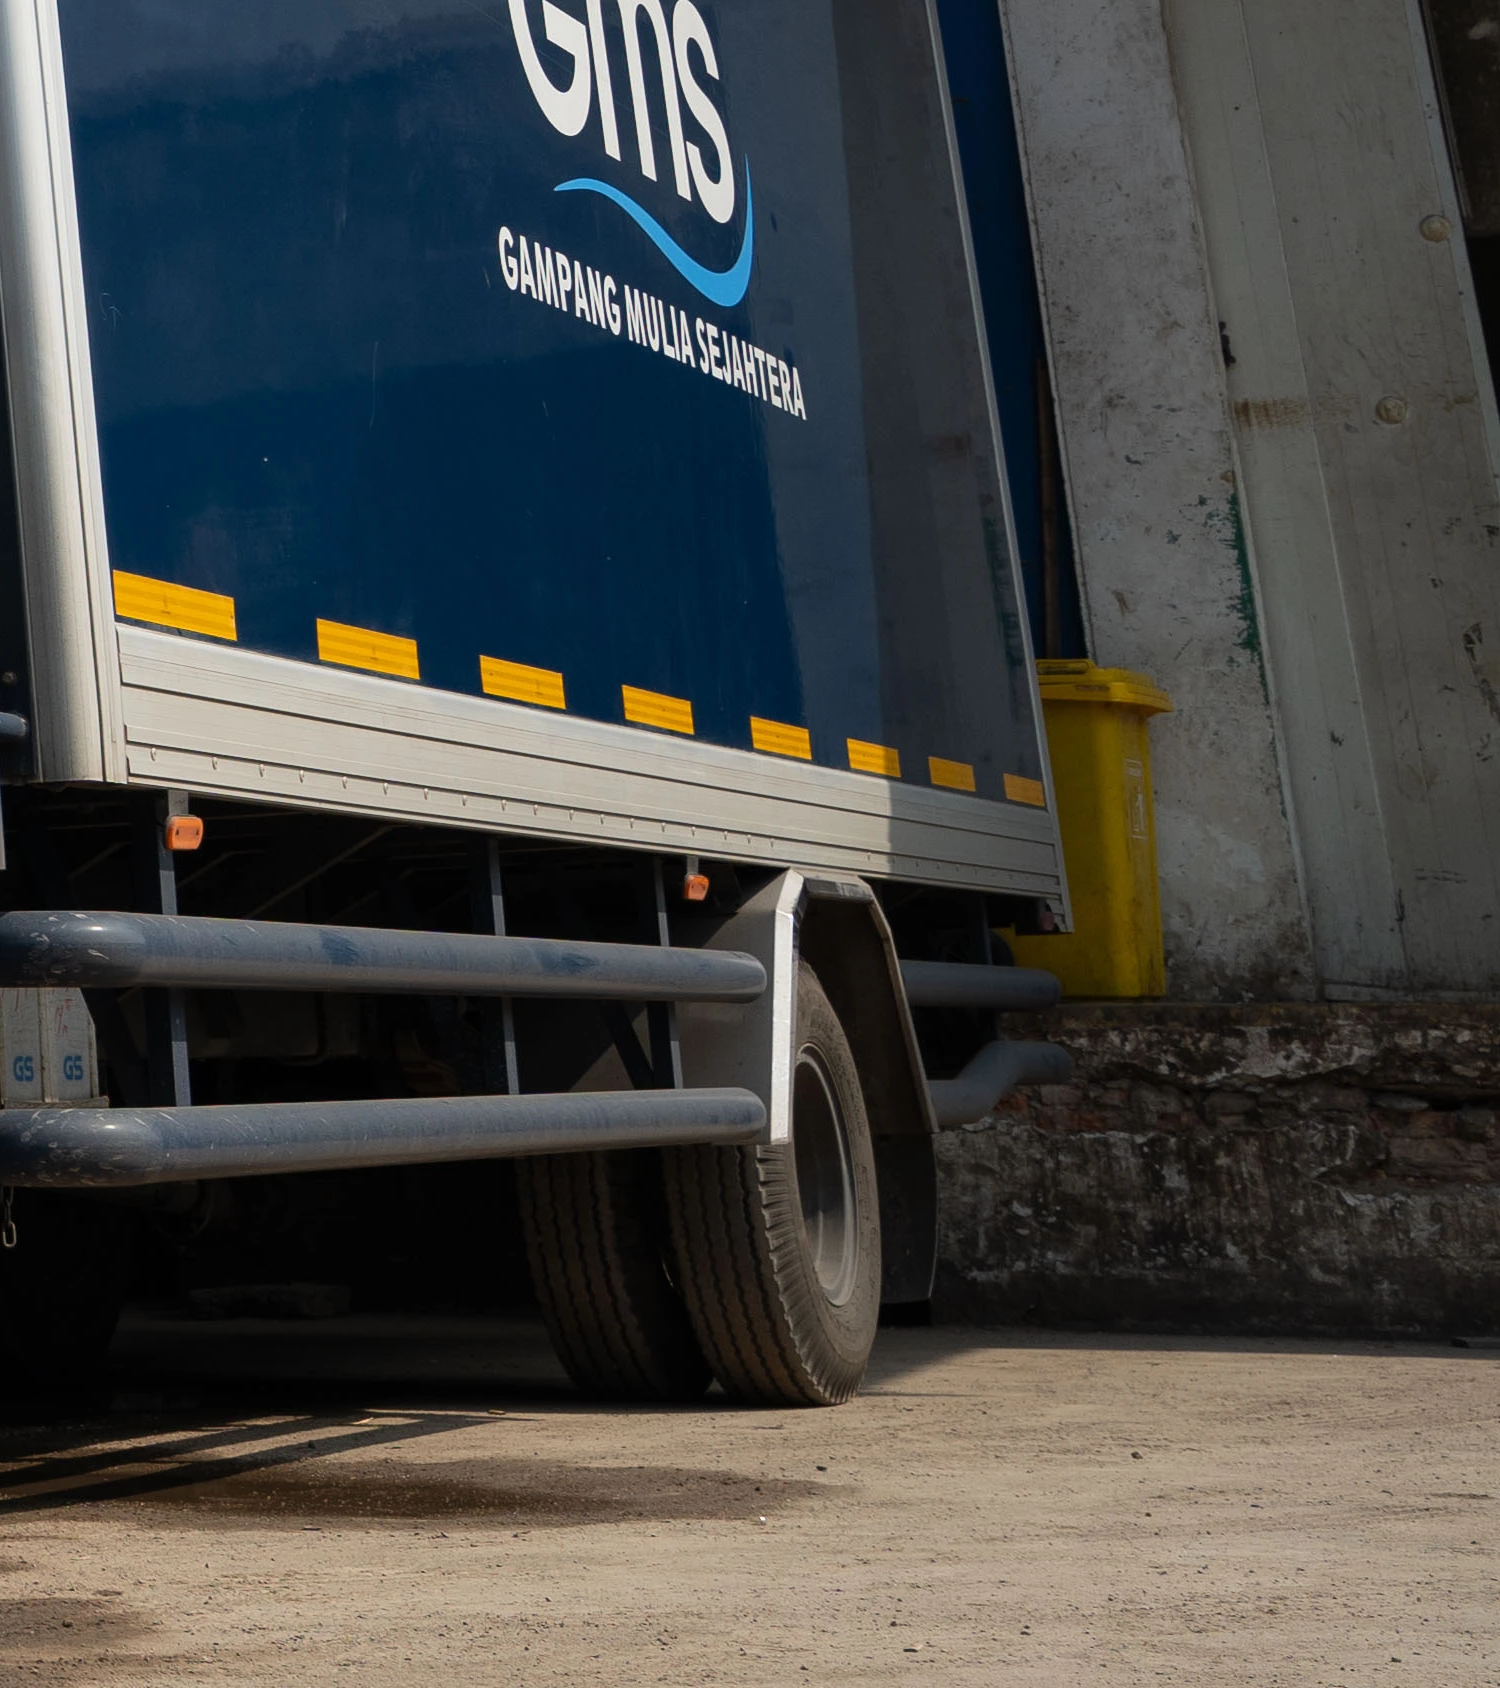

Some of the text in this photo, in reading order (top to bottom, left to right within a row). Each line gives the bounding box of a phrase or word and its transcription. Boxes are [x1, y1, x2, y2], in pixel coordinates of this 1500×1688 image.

[499, 226, 807, 421] GAMPANG MULIA SEJAHTERA
[12, 1055, 84, 1082] GS GS
